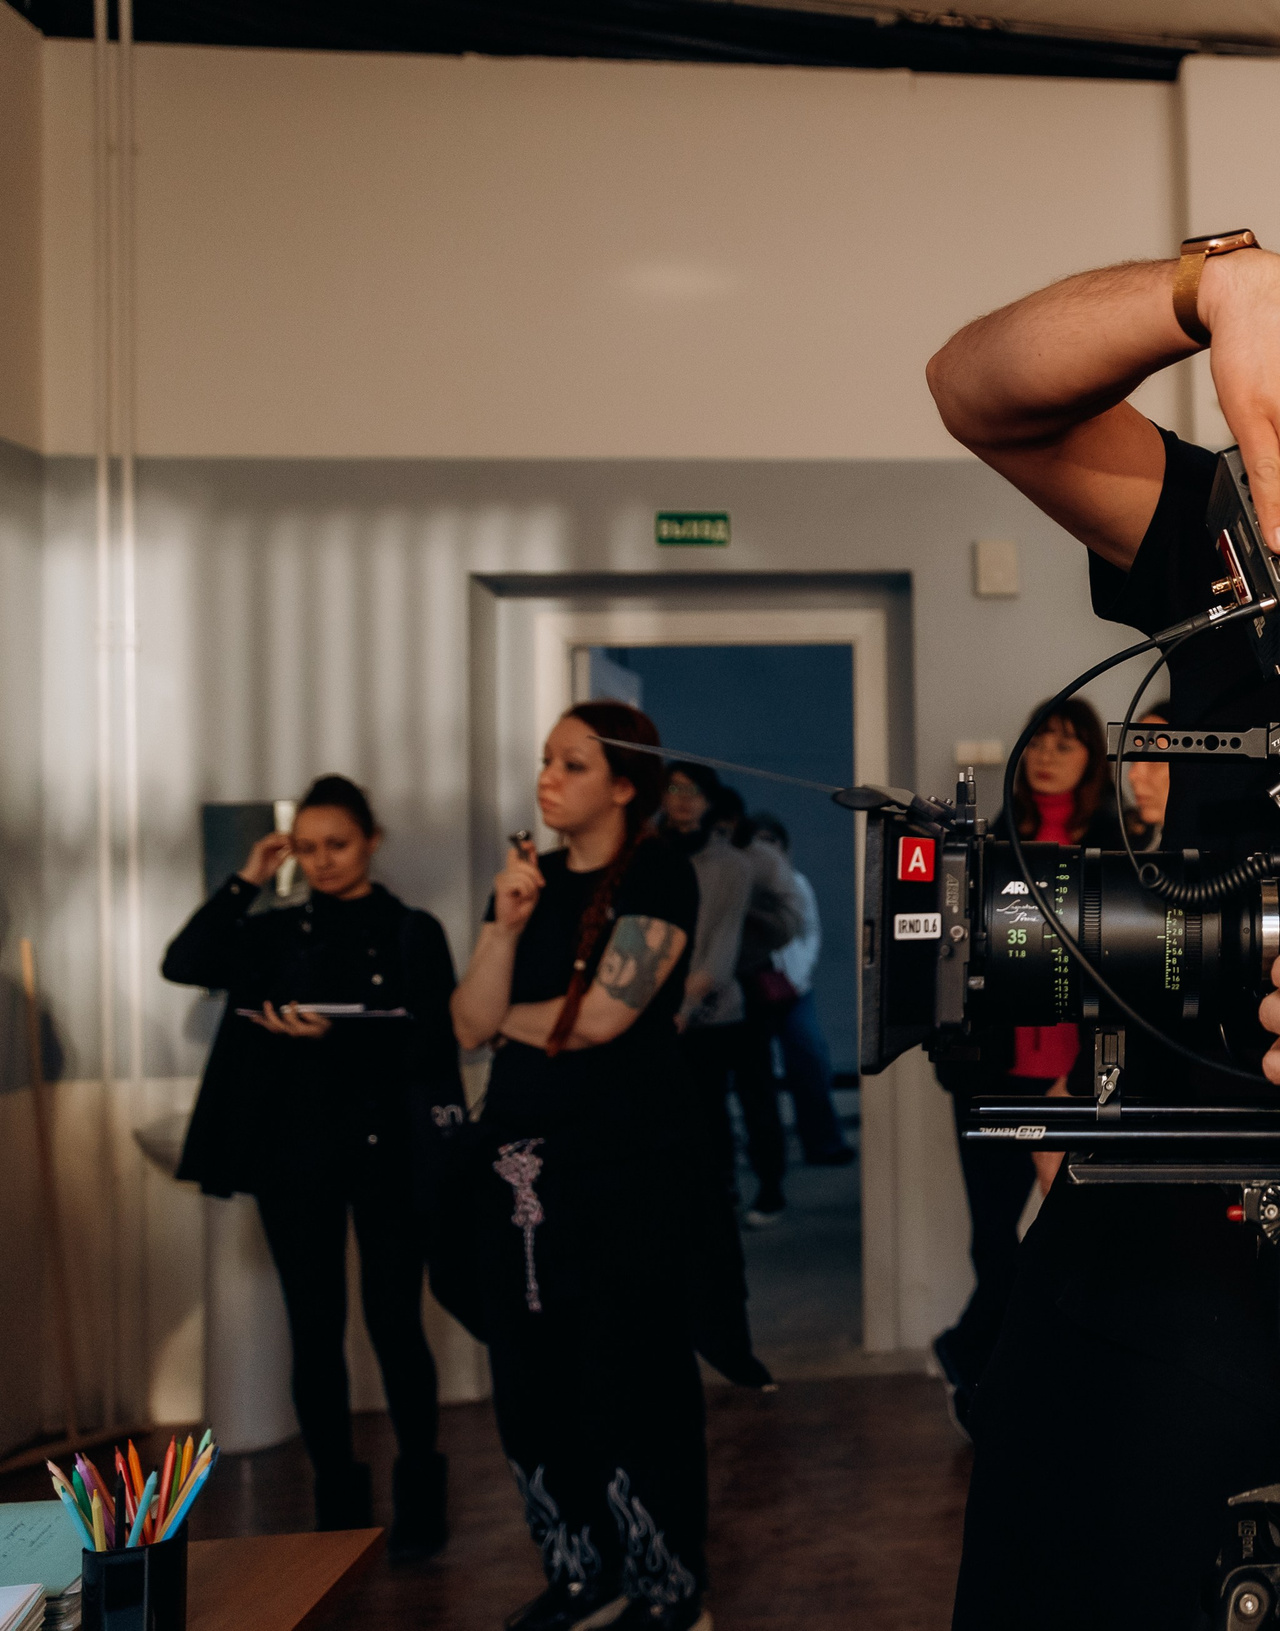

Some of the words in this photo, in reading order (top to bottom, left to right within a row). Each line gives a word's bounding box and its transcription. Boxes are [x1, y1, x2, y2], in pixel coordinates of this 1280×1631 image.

[908, 846, 927, 873] A
[1060, 886, 1068, 894] 10
[899, 919, 921, 934] IRND
[924, 919, 938, 933] 0.6
[1172, 928, 1183, 936] 2.8
[1007, 928, 1027, 945] 35
[1172, 947, 1183, 956] 5.6
[1172, 966, 1180, 974] 11
[1172, 975, 1180, 983] 16
